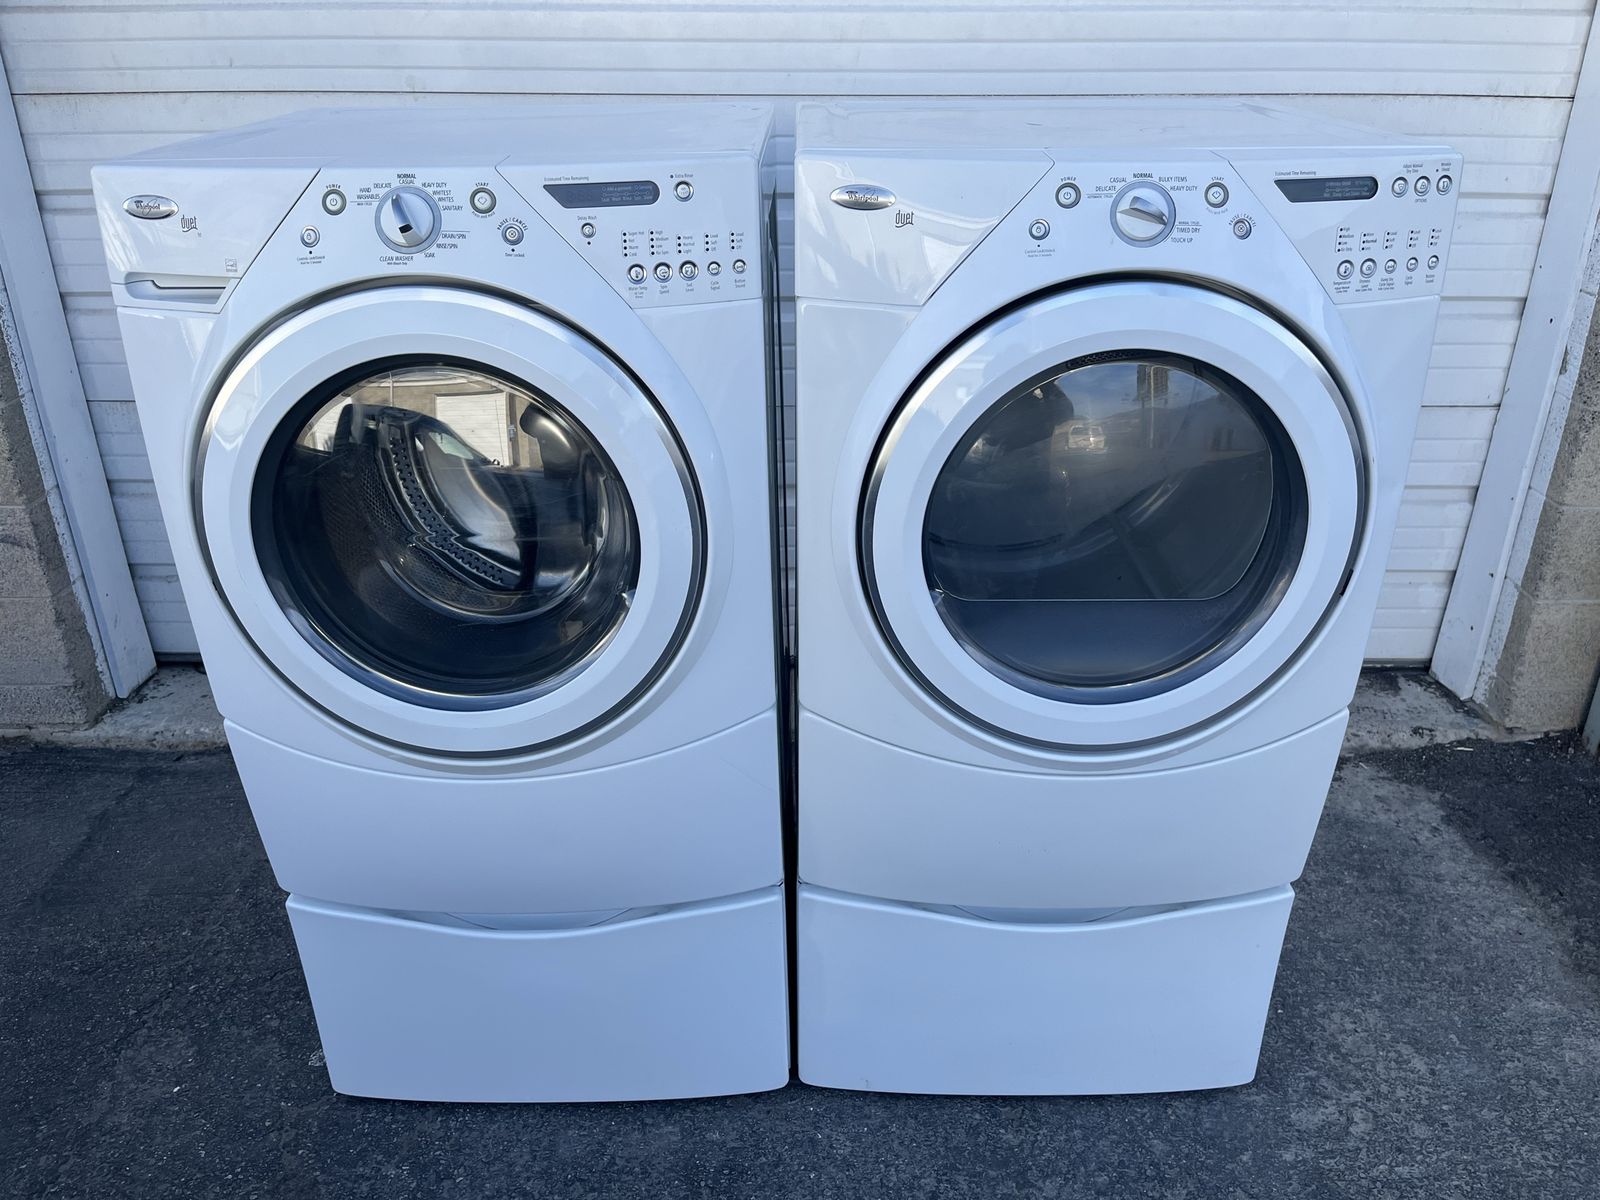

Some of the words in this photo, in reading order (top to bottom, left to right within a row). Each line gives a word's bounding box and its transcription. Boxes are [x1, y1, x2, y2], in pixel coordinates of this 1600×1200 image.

[846, 190, 879, 202] Whirlpool
[181, 214, 198, 232] duet
[497, 219, 508, 230] PAUSE
[512, 218, 528, 231] CANCEL
[895, 210, 914, 228] duet
[1229, 215, 1240, 226] PAUSE
[1244, 214, 1256, 228] CANCEL
